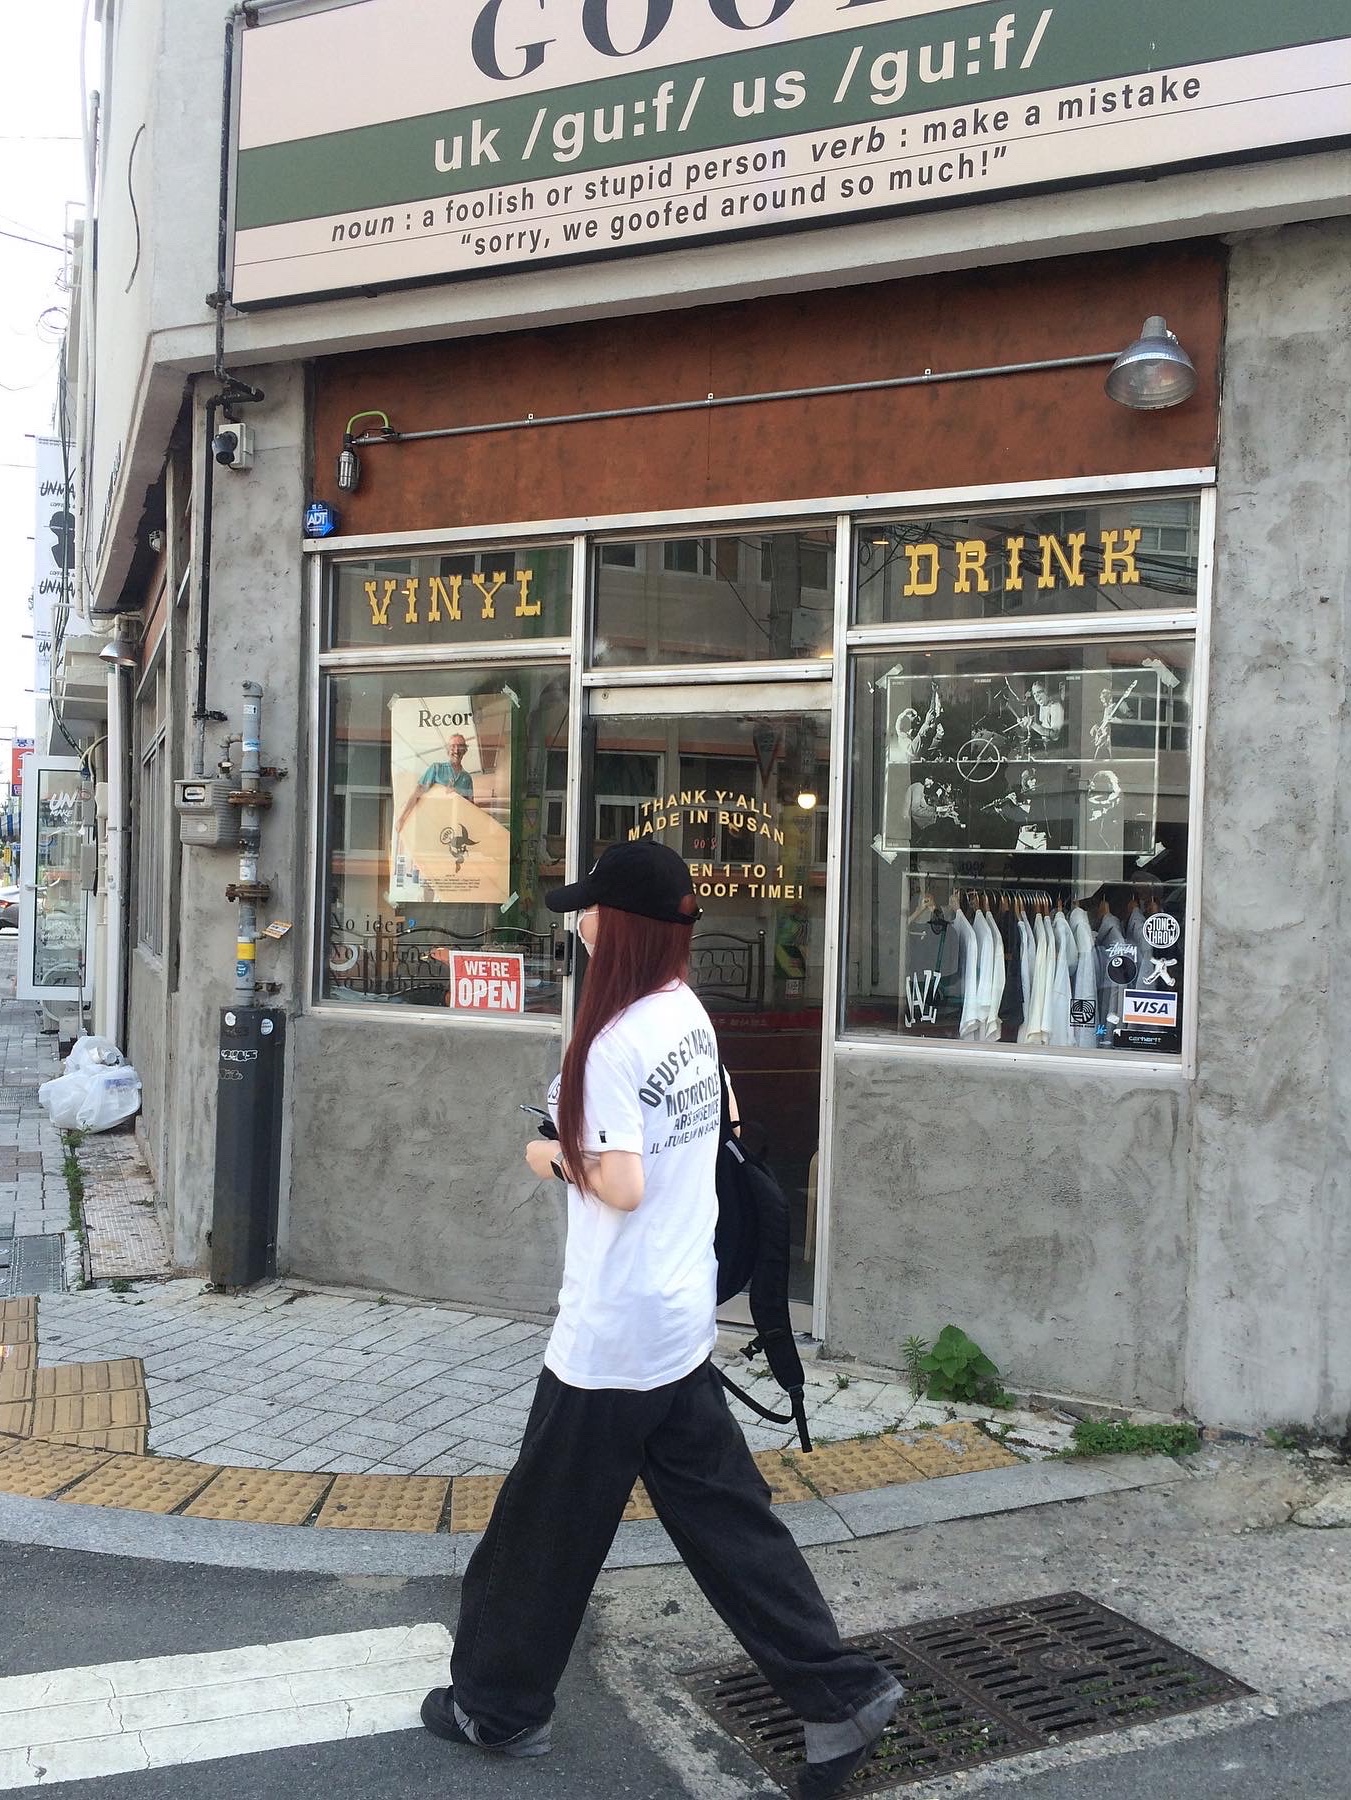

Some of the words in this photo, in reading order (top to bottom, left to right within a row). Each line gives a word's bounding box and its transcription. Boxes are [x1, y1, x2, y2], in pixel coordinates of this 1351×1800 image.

[434, 118, 500, 173] uk
[521, 77, 706, 168] /gu:f/
[731, 69, 807, 118] us
[833, 9, 1053, 103] /gu:f/
[331, 214, 394, 243] noun
[423, 210, 435, 228] a
[446, 192, 535, 223] foolish
[546, 182, 573, 206] or
[584, 161, 672, 201] stupid
[685, 148, 787, 189] person
[811, 126, 885, 163] verb
[923, 109, 1010, 144] make
[1024, 106, 1041, 126] a
[1058, 75, 1202, 121] mistake
[562, 219, 599, 243] we
[610, 196, 708, 240] goofed
[720, 175, 826, 218] around
[840, 173, 875, 199] so
[307, 511, 328, 525] ADT
[902, 527, 1142, 597] DRINK
[364, 569, 542, 626] VINYL
[641, 789, 708, 817] THANK
[628, 813, 681, 842] MADE
[689, 810, 709, 825] IN
[718, 811, 785, 846] BUSAN
[722, 863, 731, 877] 1
[742, 863, 766, 878] TO
[776, 863, 785, 878] 1
[748, 883, 804, 899] TIME!
[1147, 917, 1176, 931] STONES
[1148, 930, 1176, 945] THROW
[458, 979, 517, 1009] OPEN
[1132, 1000, 1169, 1014] VISA
[638, 1051, 679, 1108] DEUS
